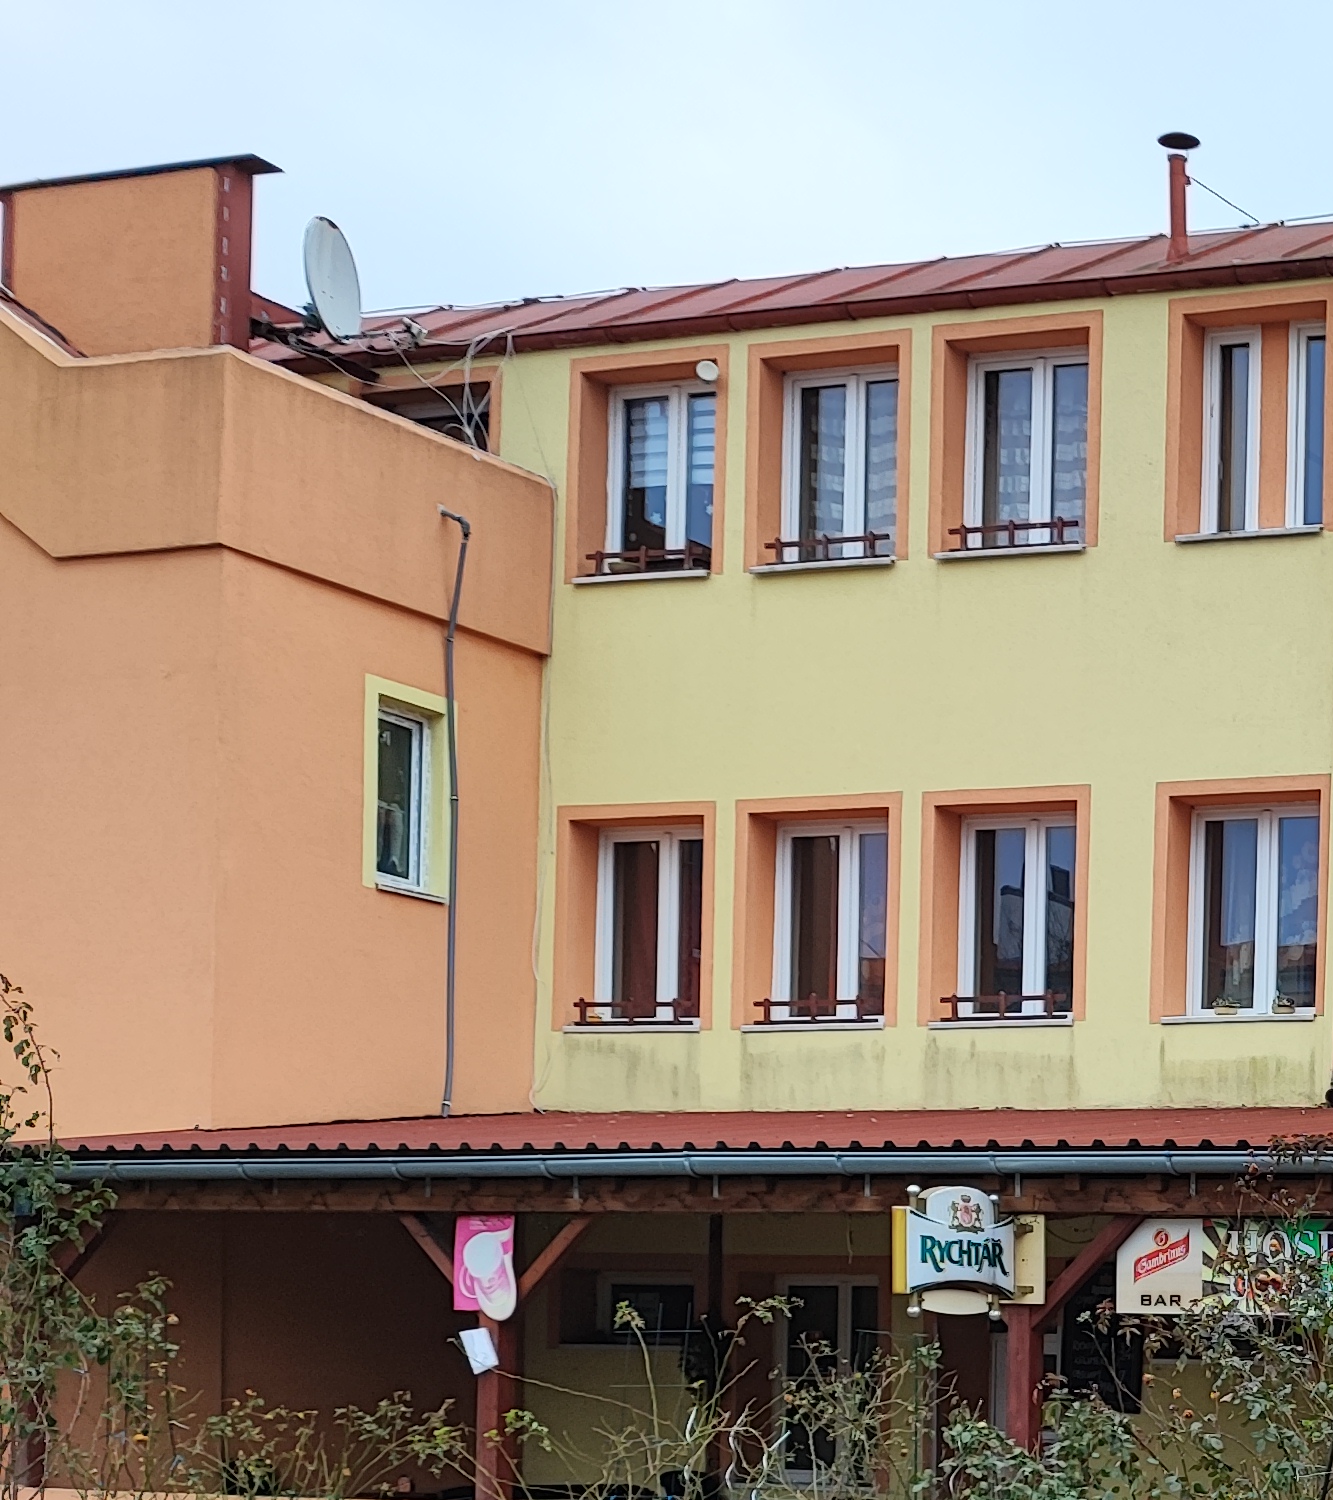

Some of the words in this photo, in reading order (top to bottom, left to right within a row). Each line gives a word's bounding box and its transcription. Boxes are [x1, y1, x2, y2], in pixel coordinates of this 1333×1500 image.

[919, 1235, 1010, 1277] RYCHTÁŘ
[1136, 1244, 1187, 1274] Gambrinus
[1140, 1294, 1181, 1307] BAR
